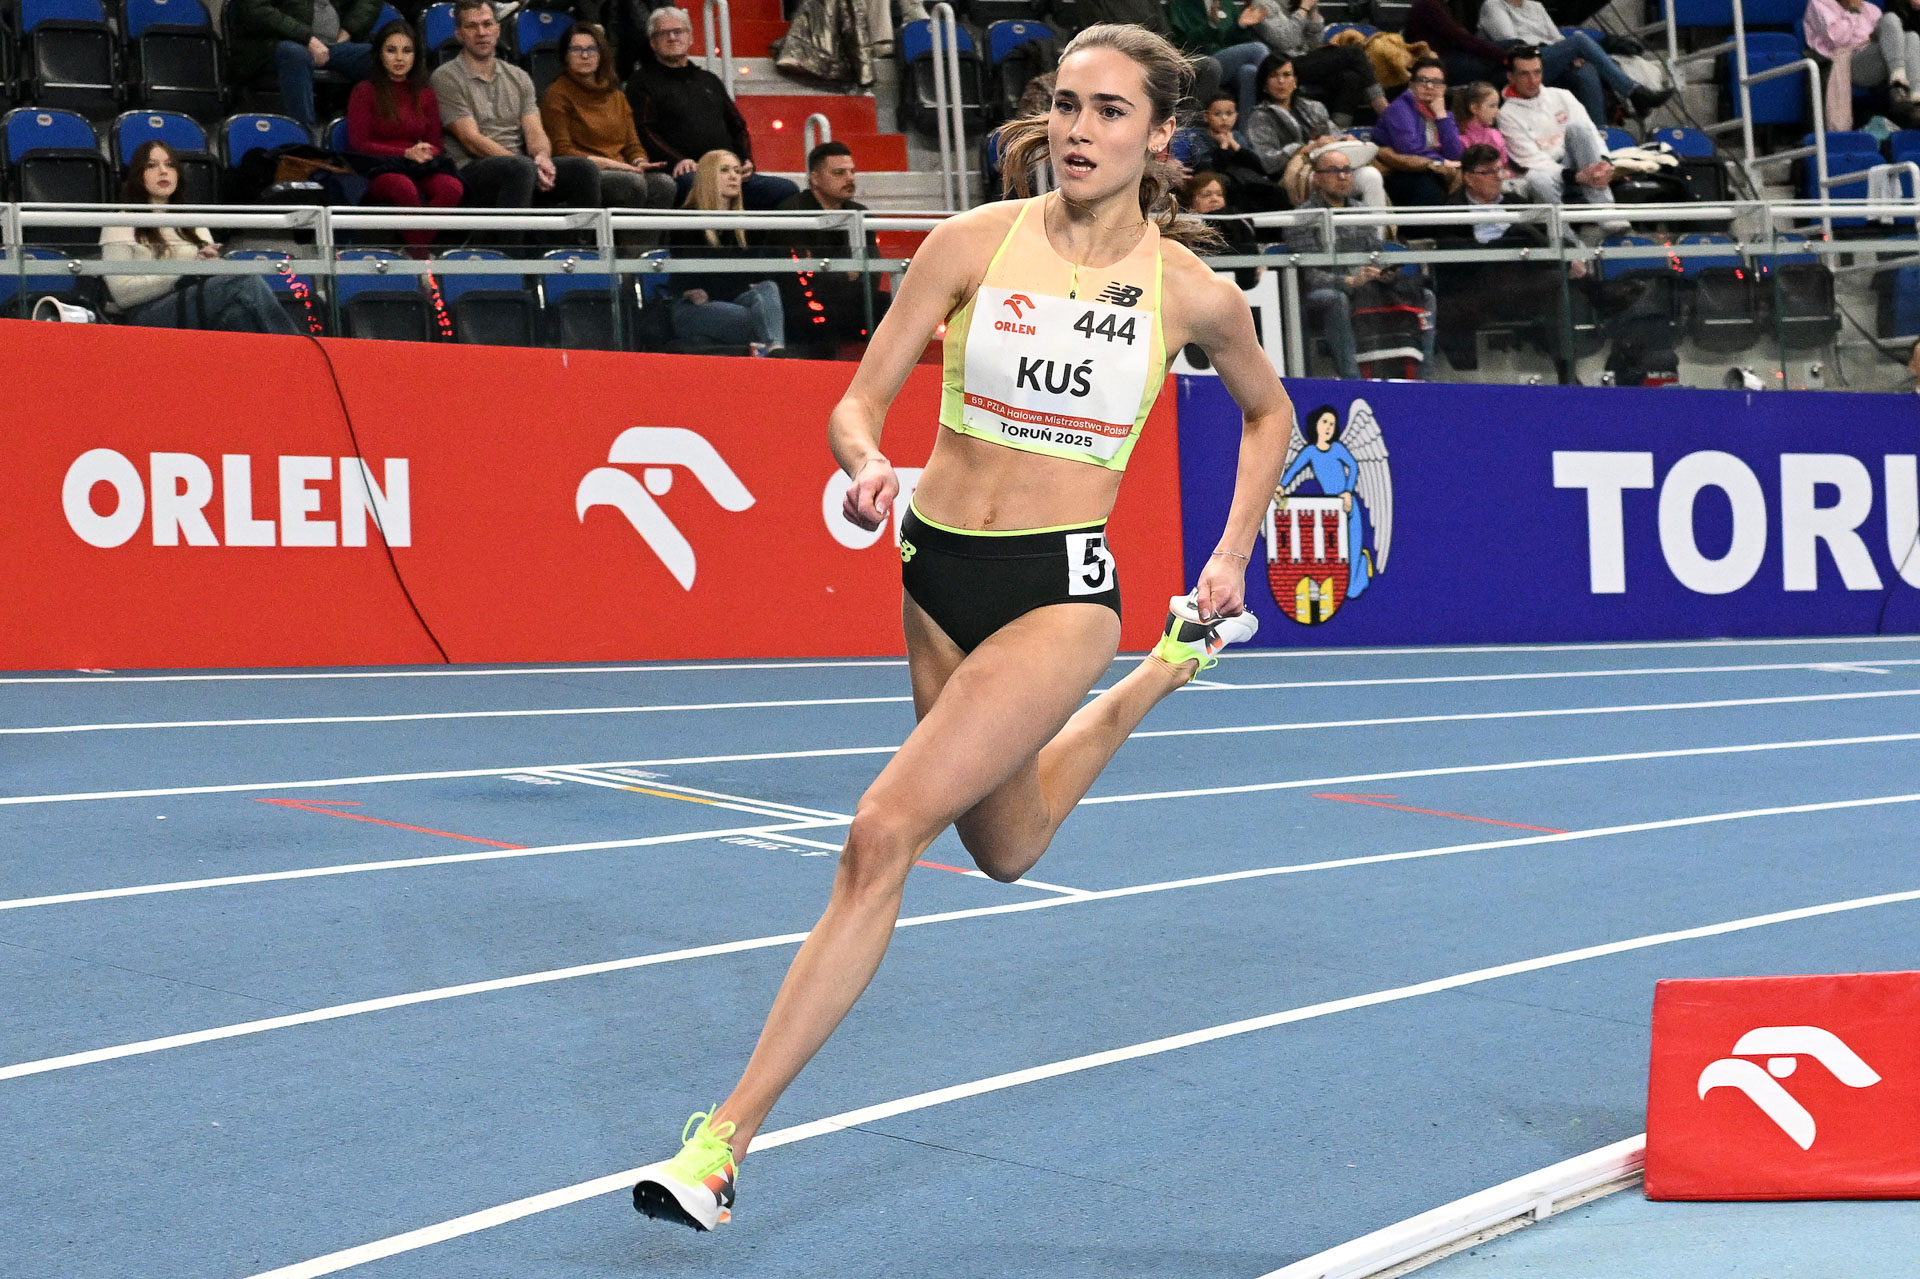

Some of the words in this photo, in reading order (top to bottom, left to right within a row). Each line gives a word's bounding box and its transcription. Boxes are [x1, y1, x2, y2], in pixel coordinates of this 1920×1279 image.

[994, 320, 1036, 336] ORLEN
[1073, 310, 1136, 346] 444
[1016, 356, 1094, 397] KUŚ
[971, 396, 986, 407] 69.
[986, 401, 1006, 414] PZLA
[1007, 408, 1043, 422] Halowe
[1044, 415, 1102, 431] Mistrzostwa
[1103, 425, 1129, 436] Polski
[1001, 421, 1052, 441] TORUŃ
[1055, 432, 1093, 448] 2025
[62, 448, 411, 549] ORLEN
[1082, 537, 1106, 588] 5
